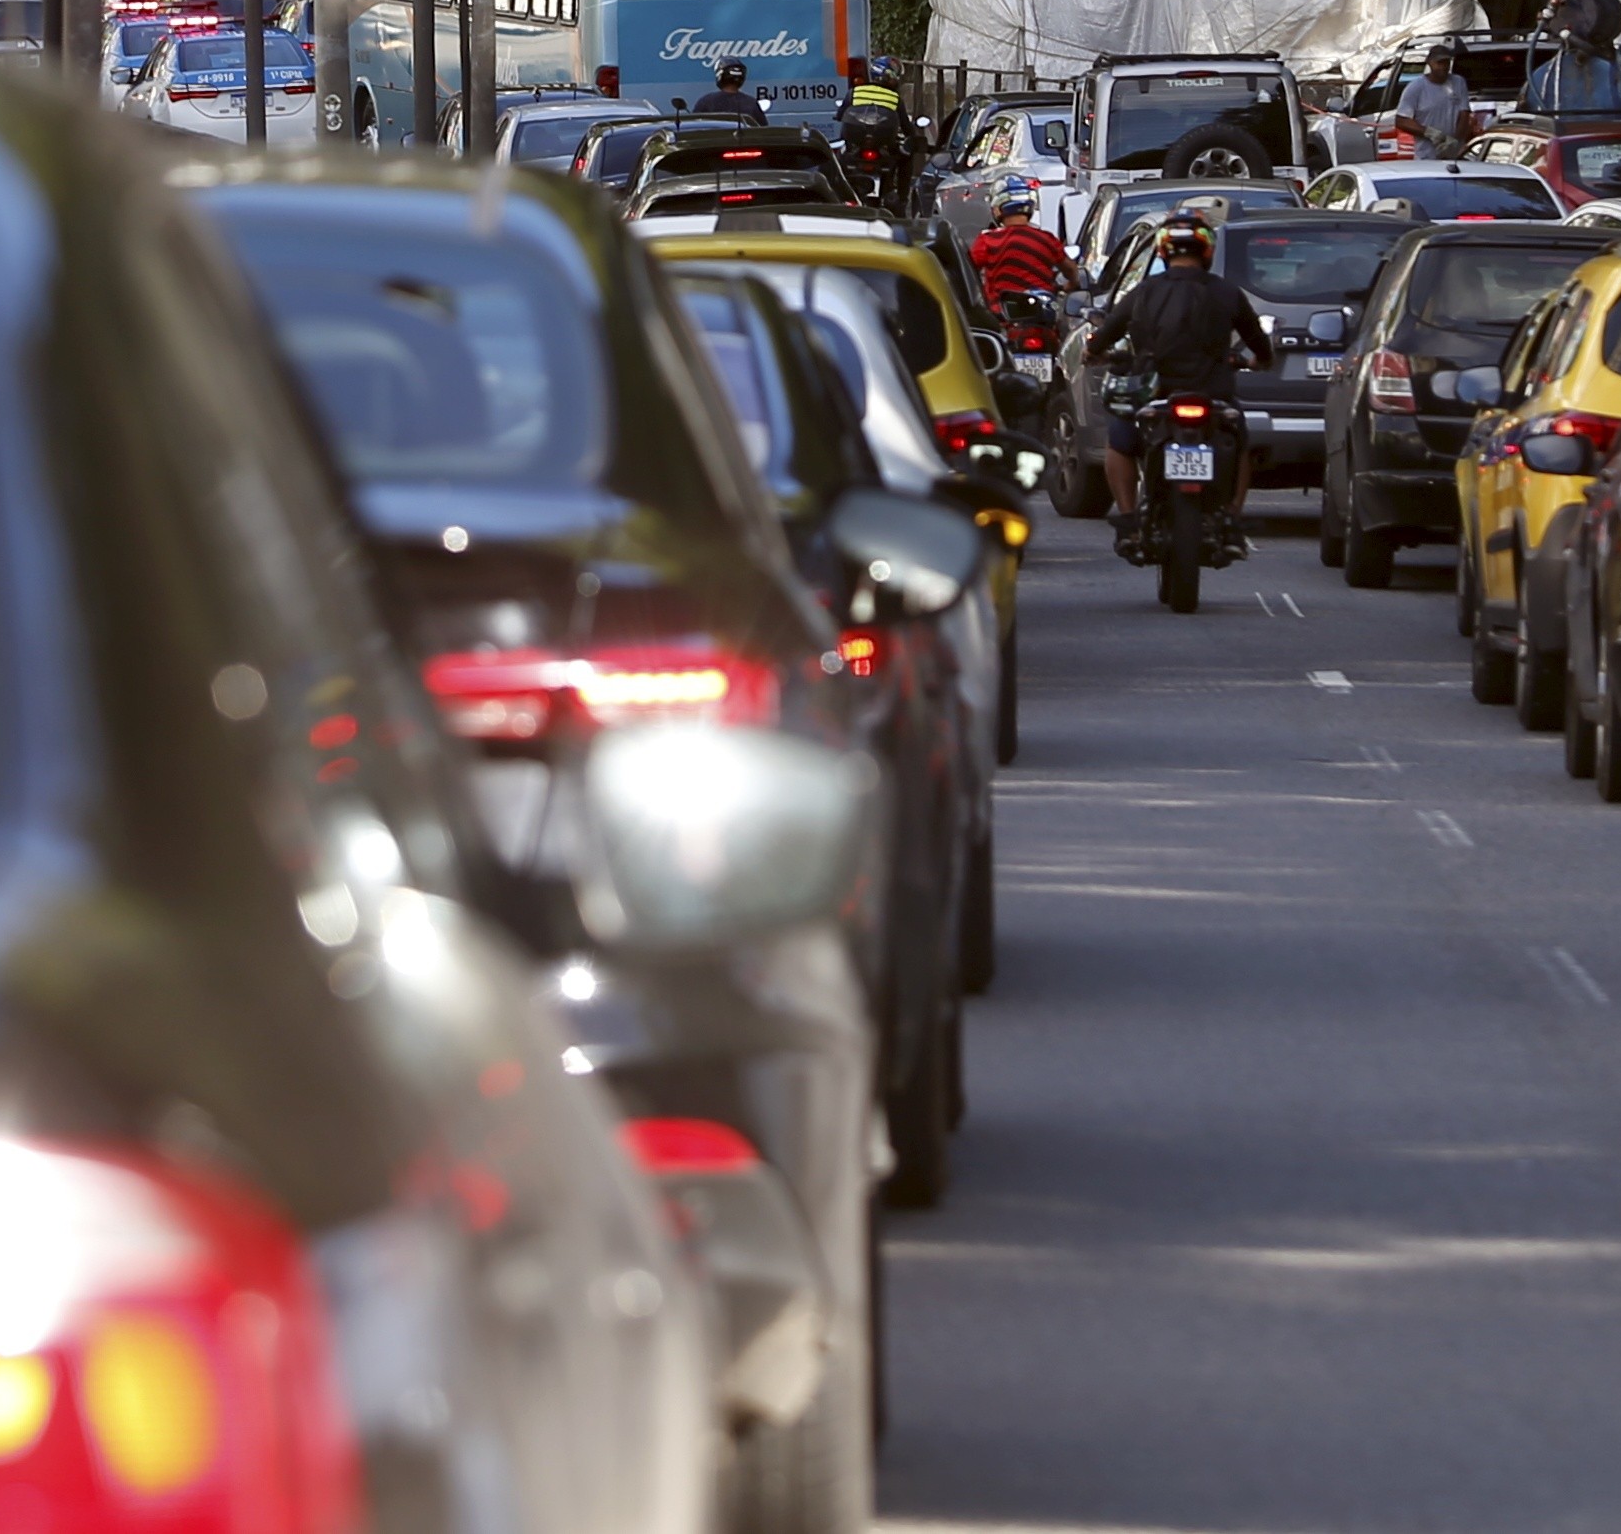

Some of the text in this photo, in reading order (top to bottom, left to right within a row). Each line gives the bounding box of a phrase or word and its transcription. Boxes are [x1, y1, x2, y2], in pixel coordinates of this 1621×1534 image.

[659, 28, 809, 67] Fagundes
[1166, 77, 1224, 87] TROLLER
[756, 84, 838, 101] RJ 101.190
